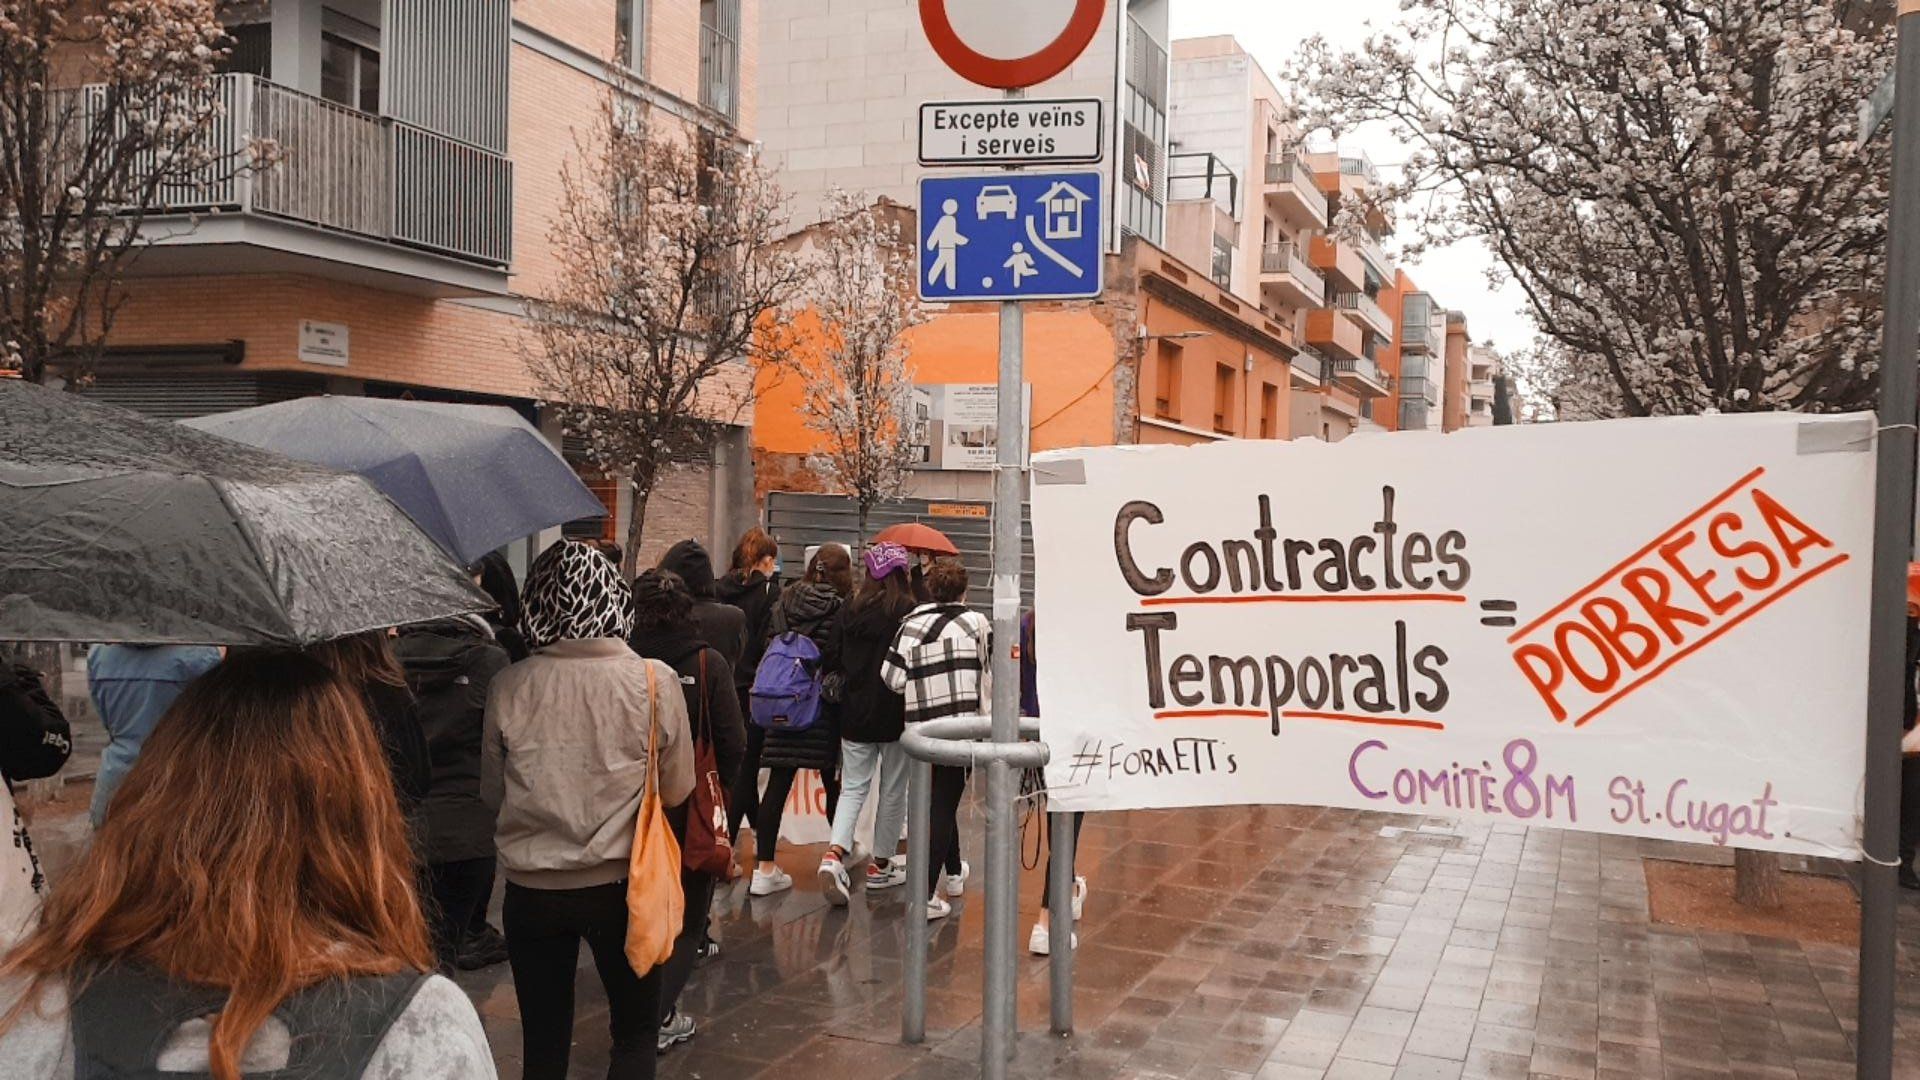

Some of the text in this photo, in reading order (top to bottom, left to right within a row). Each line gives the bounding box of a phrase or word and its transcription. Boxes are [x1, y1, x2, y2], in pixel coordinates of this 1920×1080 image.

[934, 106, 1085, 133] Excepte veïns
[961, 133, 1056, 155] i serveis
[1114, 485, 1471, 596] Contractes
[1512, 487, 1834, 723] POBRESA
[1126, 611, 1450, 736] Temporals
